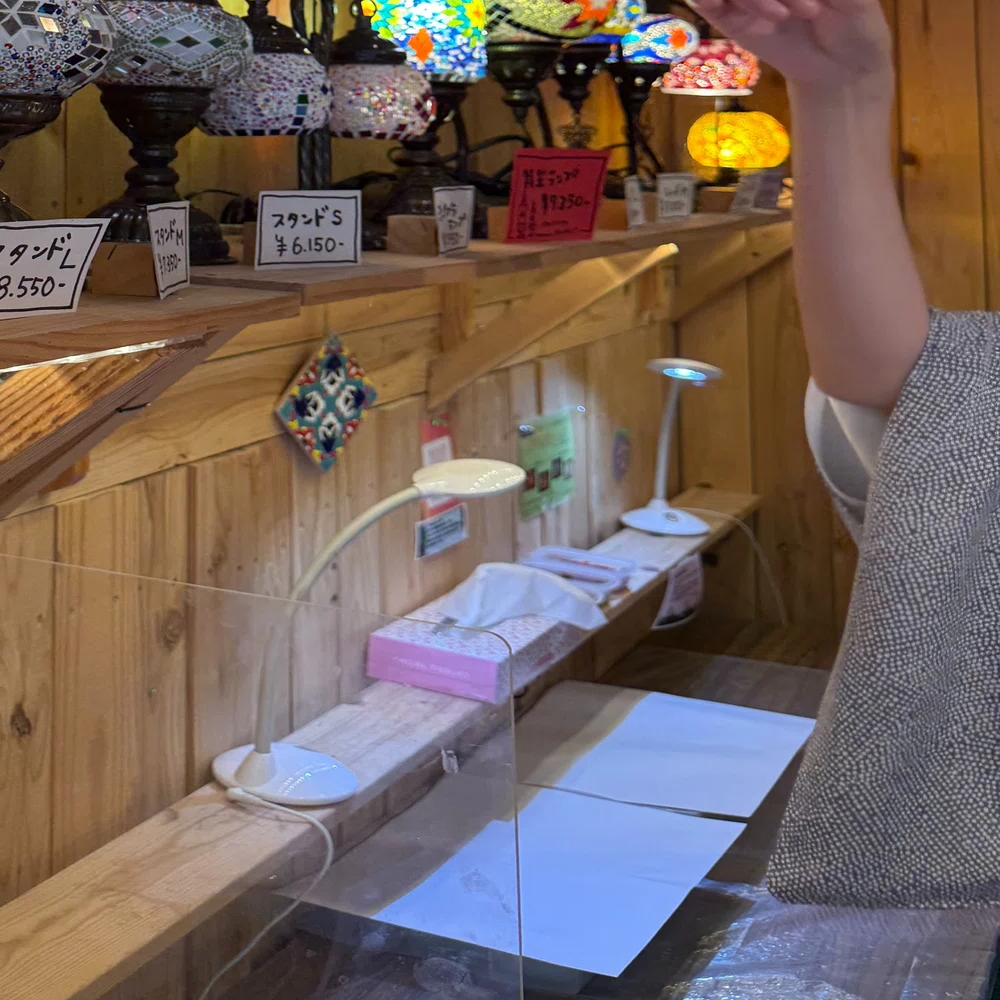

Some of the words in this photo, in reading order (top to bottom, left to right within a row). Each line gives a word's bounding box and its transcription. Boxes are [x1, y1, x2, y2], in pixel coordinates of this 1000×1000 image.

[271, 205, 344, 229] スタンドS
[274, 234, 345, 257] ¥6.150-
